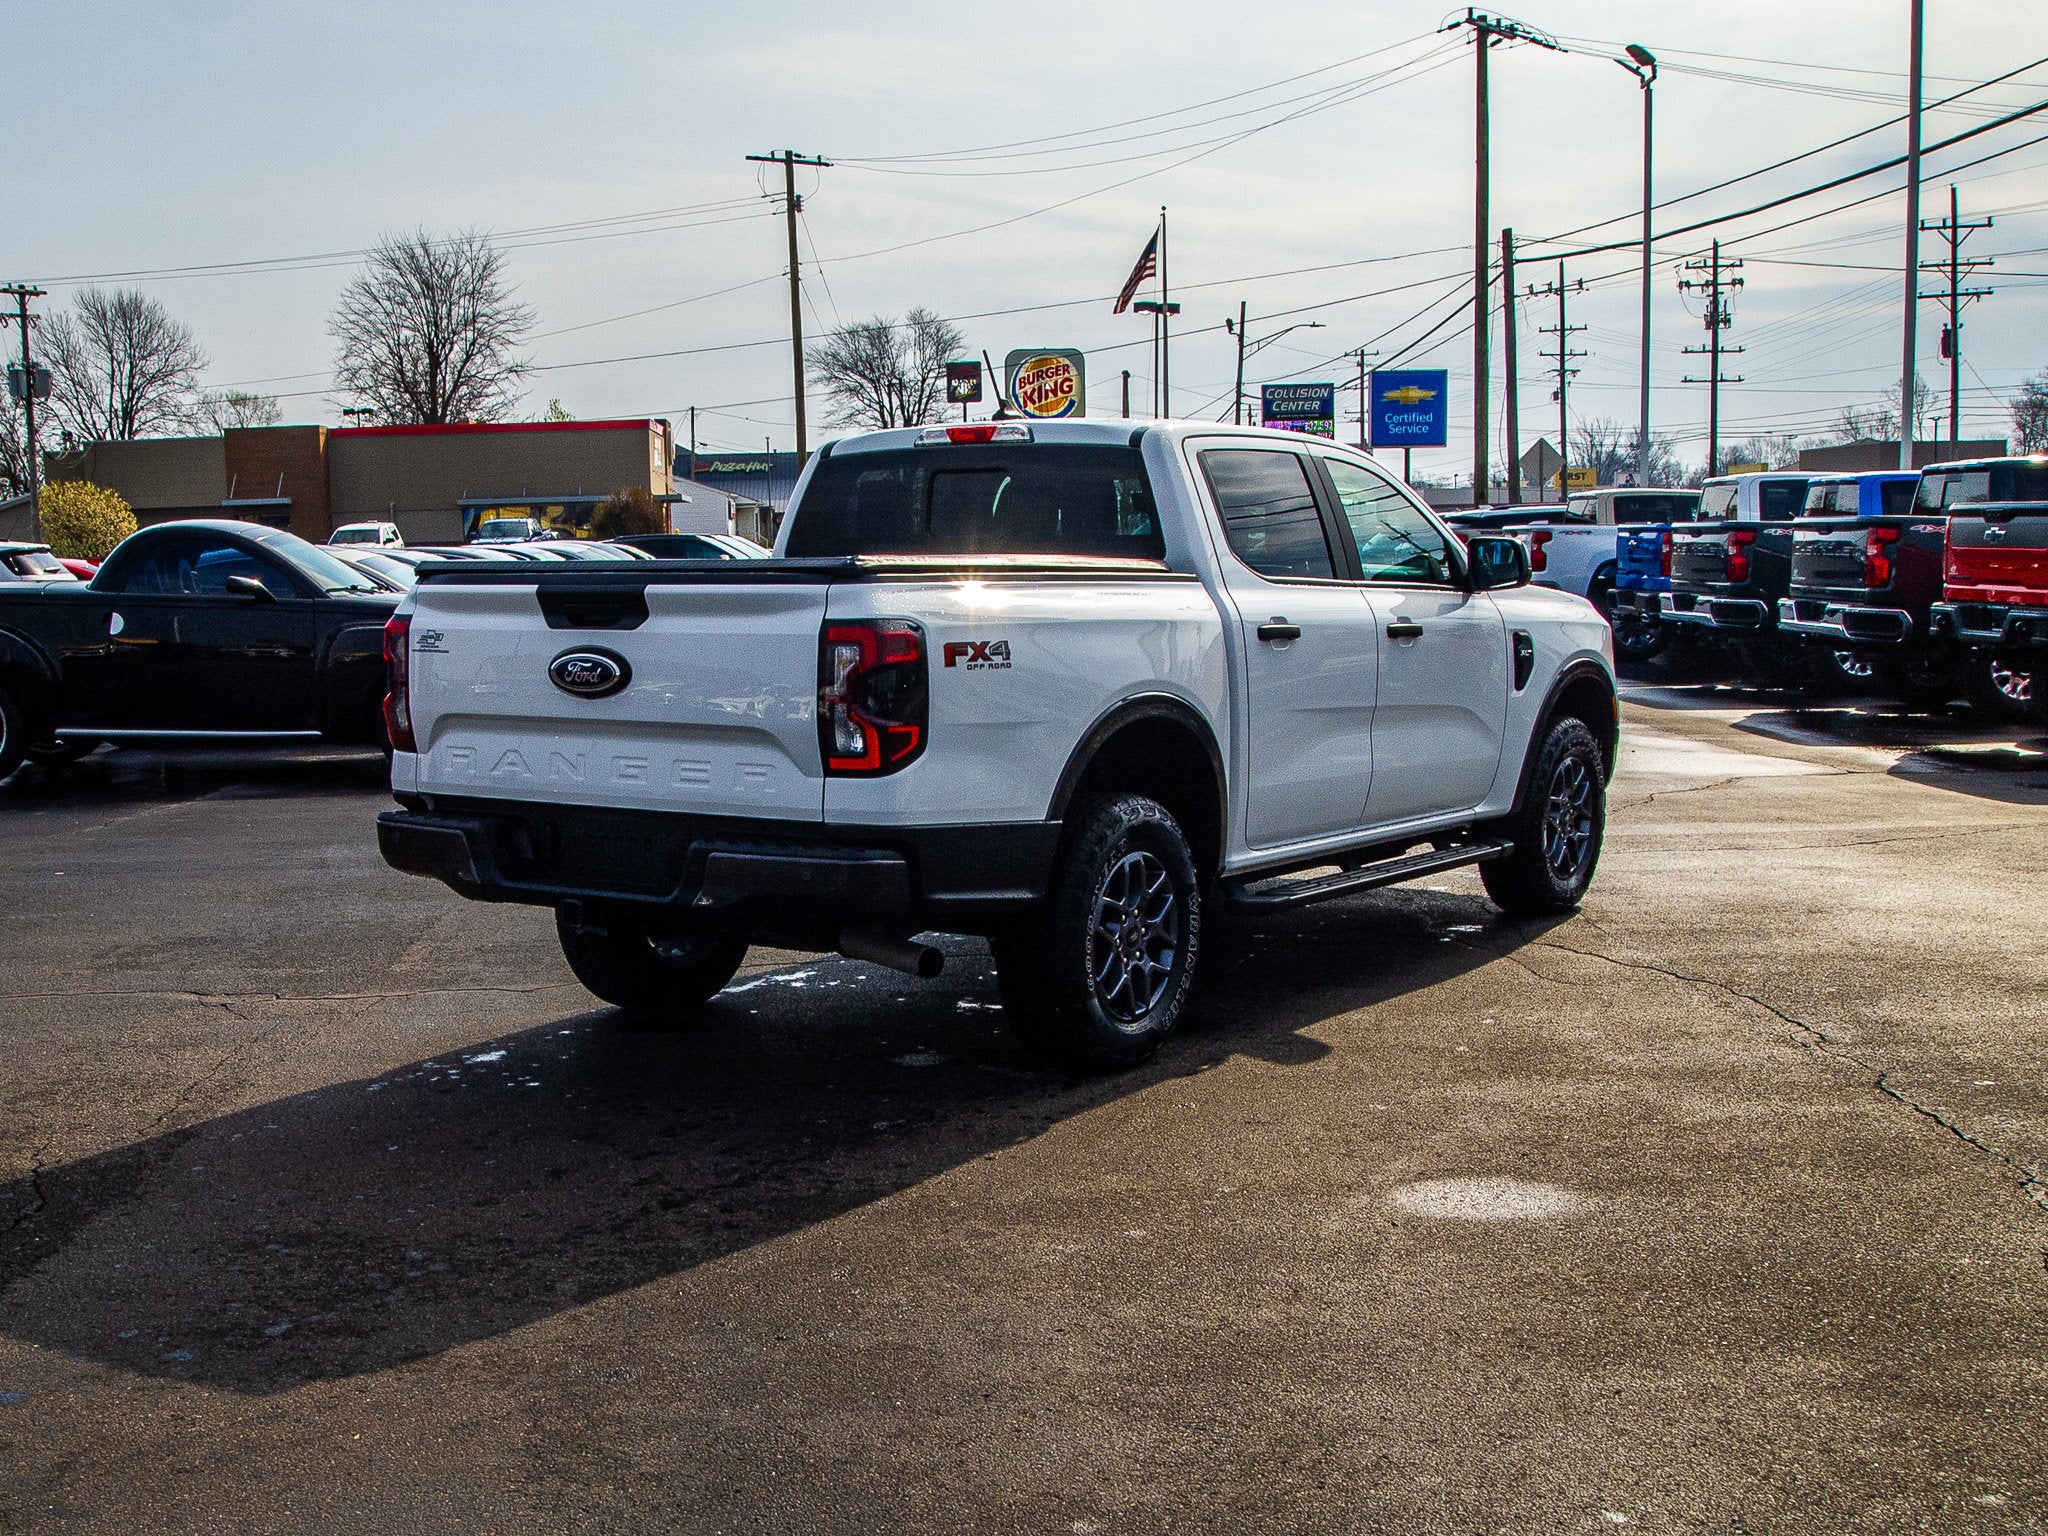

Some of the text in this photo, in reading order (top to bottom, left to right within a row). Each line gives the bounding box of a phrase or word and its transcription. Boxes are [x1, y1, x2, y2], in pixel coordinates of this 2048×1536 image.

[1018, 363, 1071, 391] BURGER
[1021, 377, 1074, 409] KING
[1266, 387, 1330, 399] COLLISION
[1272, 400, 1321, 411] CENTER
[1385, 412, 1433, 423] Certified
[1388, 423, 1429, 434] Service
[943, 640, 1011, 667] FX4
[565, 660, 602, 684] Ford
[966, 662, 1012, 671] OFF ROAD
[446, 745, 778, 793] RANGER
